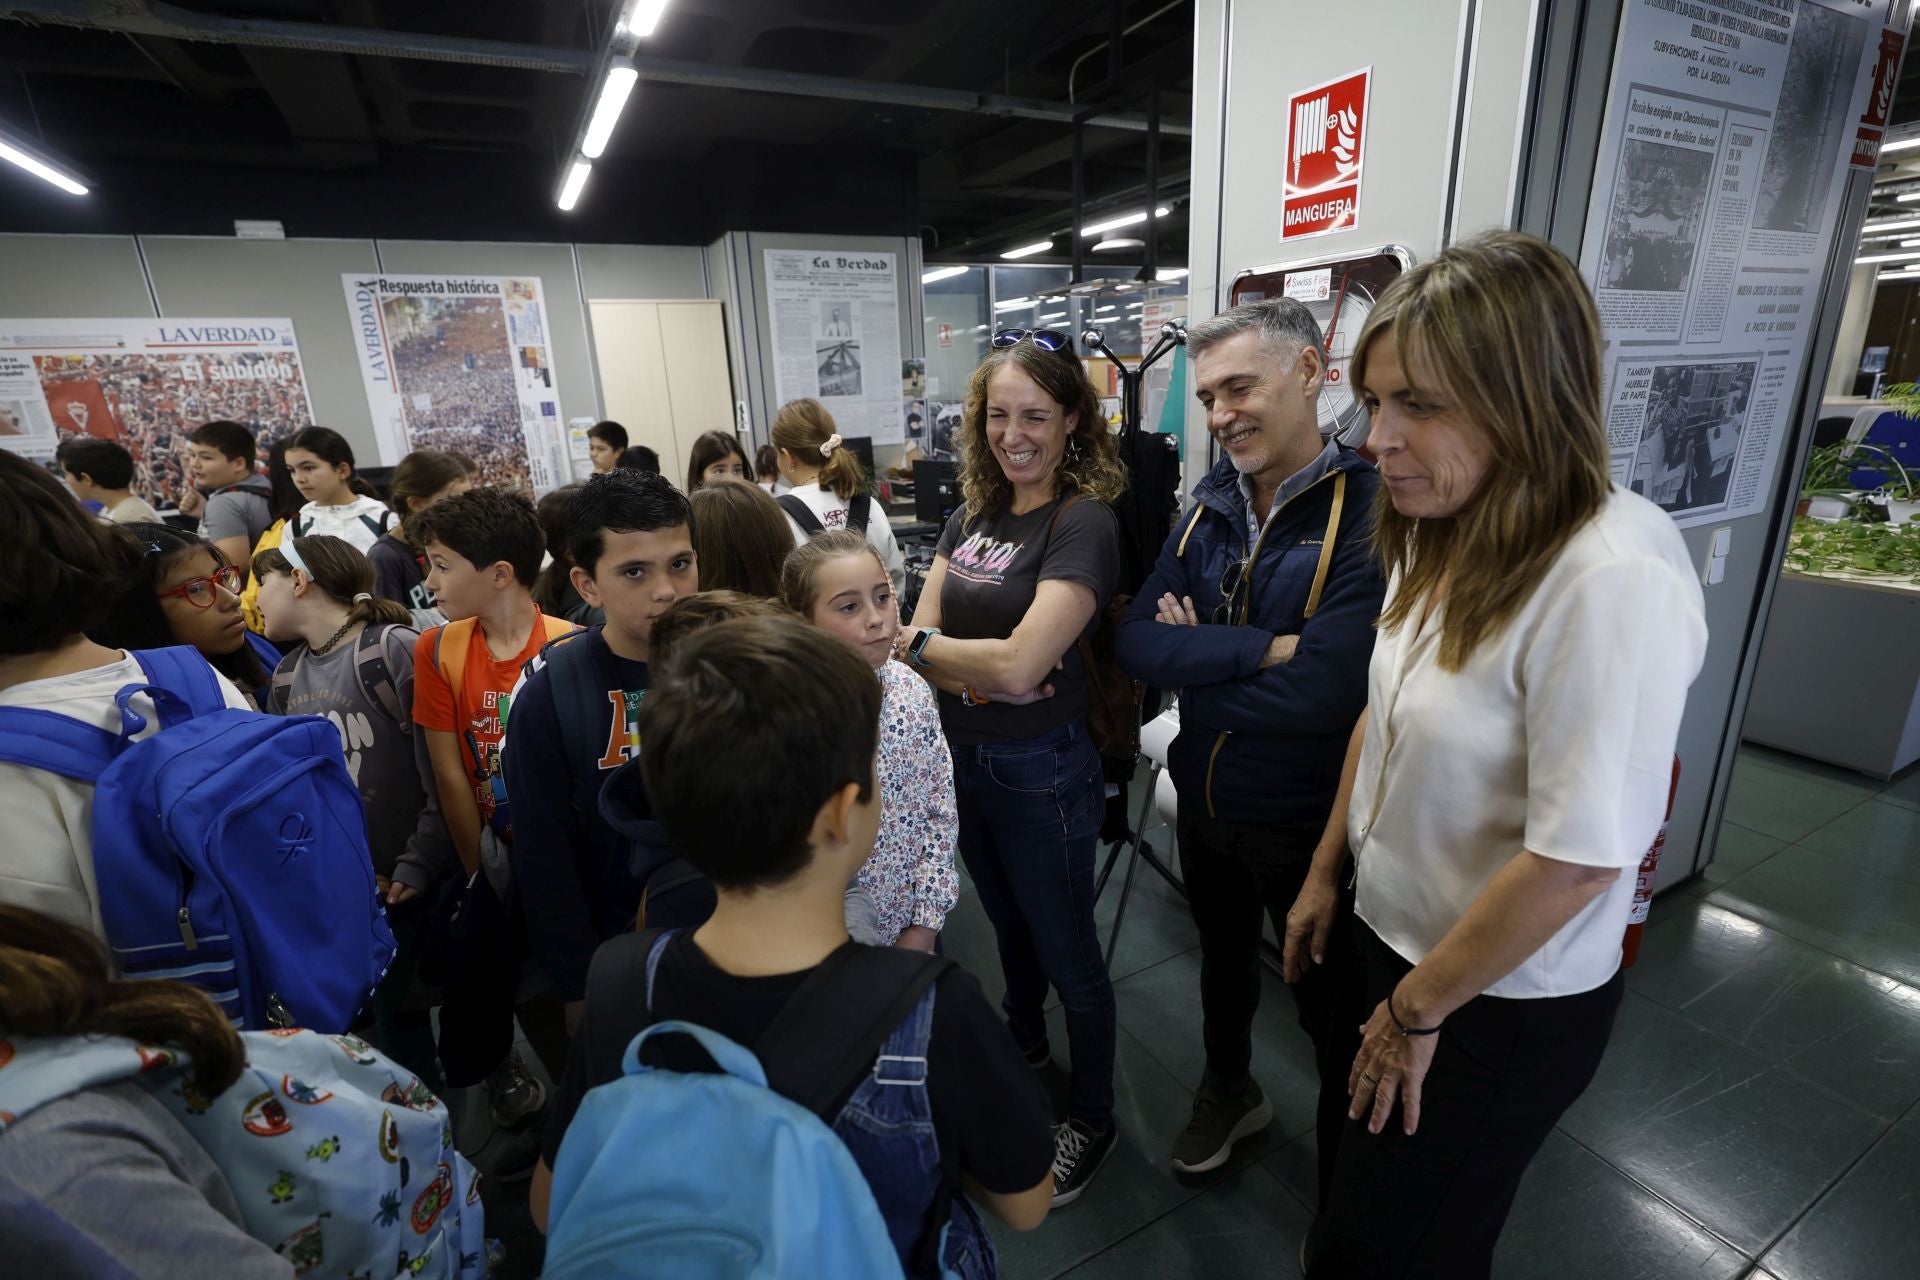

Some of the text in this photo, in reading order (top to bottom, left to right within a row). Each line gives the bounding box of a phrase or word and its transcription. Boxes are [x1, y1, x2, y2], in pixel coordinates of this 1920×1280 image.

[1653, 40, 1766, 78] SUBVENCIONES A MURCIA Y ALICANTE
[1686, 65, 1700, 78] POR
[1700, 69, 1709, 80] LA
[1627, 123, 1636, 133] se
[1285, 197, 1352, 227] MANGUERA
[811, 256, 831, 268] La
[835, 257, 888, 271] Verdad
[379, 279, 500, 296] Respuesta histórica
[1292, 274, 1330, 287] Swiss Fire
[159, 327, 275, 342] LA VERDAD
[355, 288, 388, 382] LA VERDAD
[209, 359, 293, 380] subidón
[1627, 367, 1652, 376] TAMBIEN
[1625, 379, 1650, 389] MUEBLES
[1620, 390, 1647, 400] DE PAPEL
